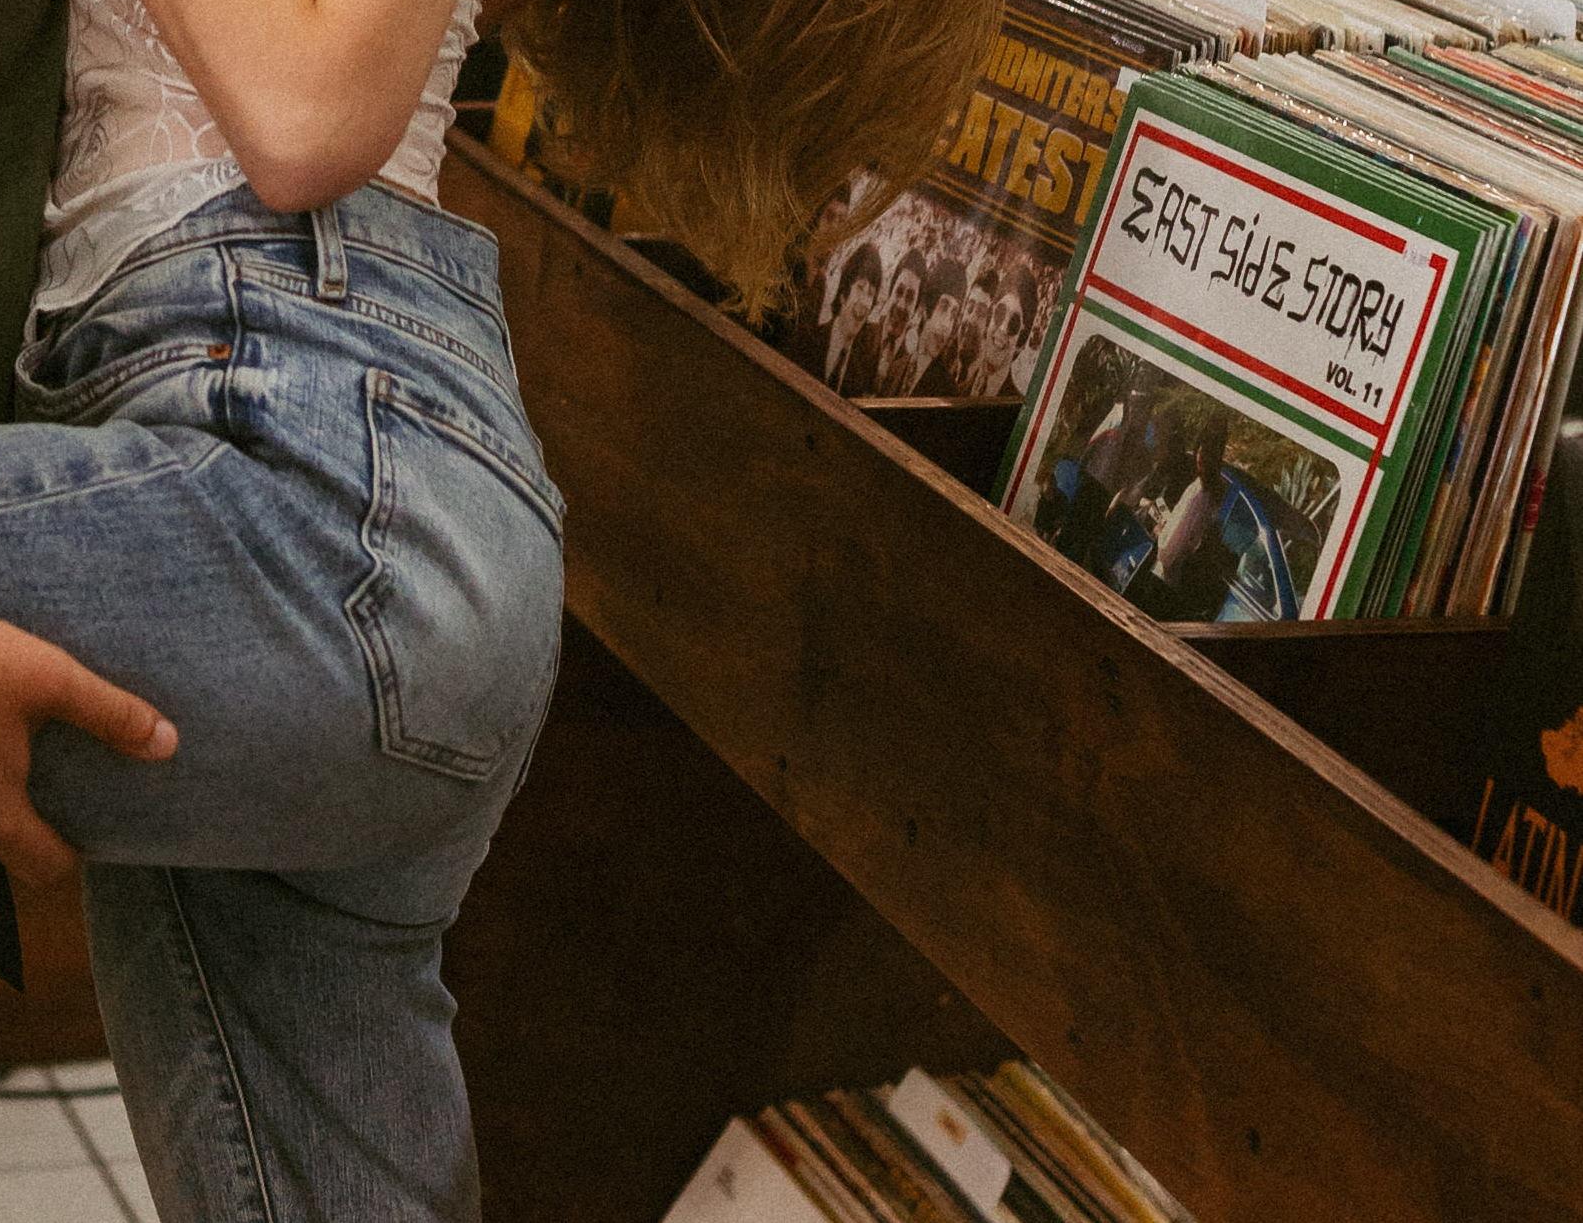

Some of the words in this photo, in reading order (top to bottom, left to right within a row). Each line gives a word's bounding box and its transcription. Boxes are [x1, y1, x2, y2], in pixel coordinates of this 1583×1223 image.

[982, 33, 1129, 134] IDNITERS
[1120, 166, 1220, 272] EAST
[1286, 254, 1405, 362] STORY
[1325, 360, 1357, 397] VOL.
[1363, 381, 1384, 408] 11
